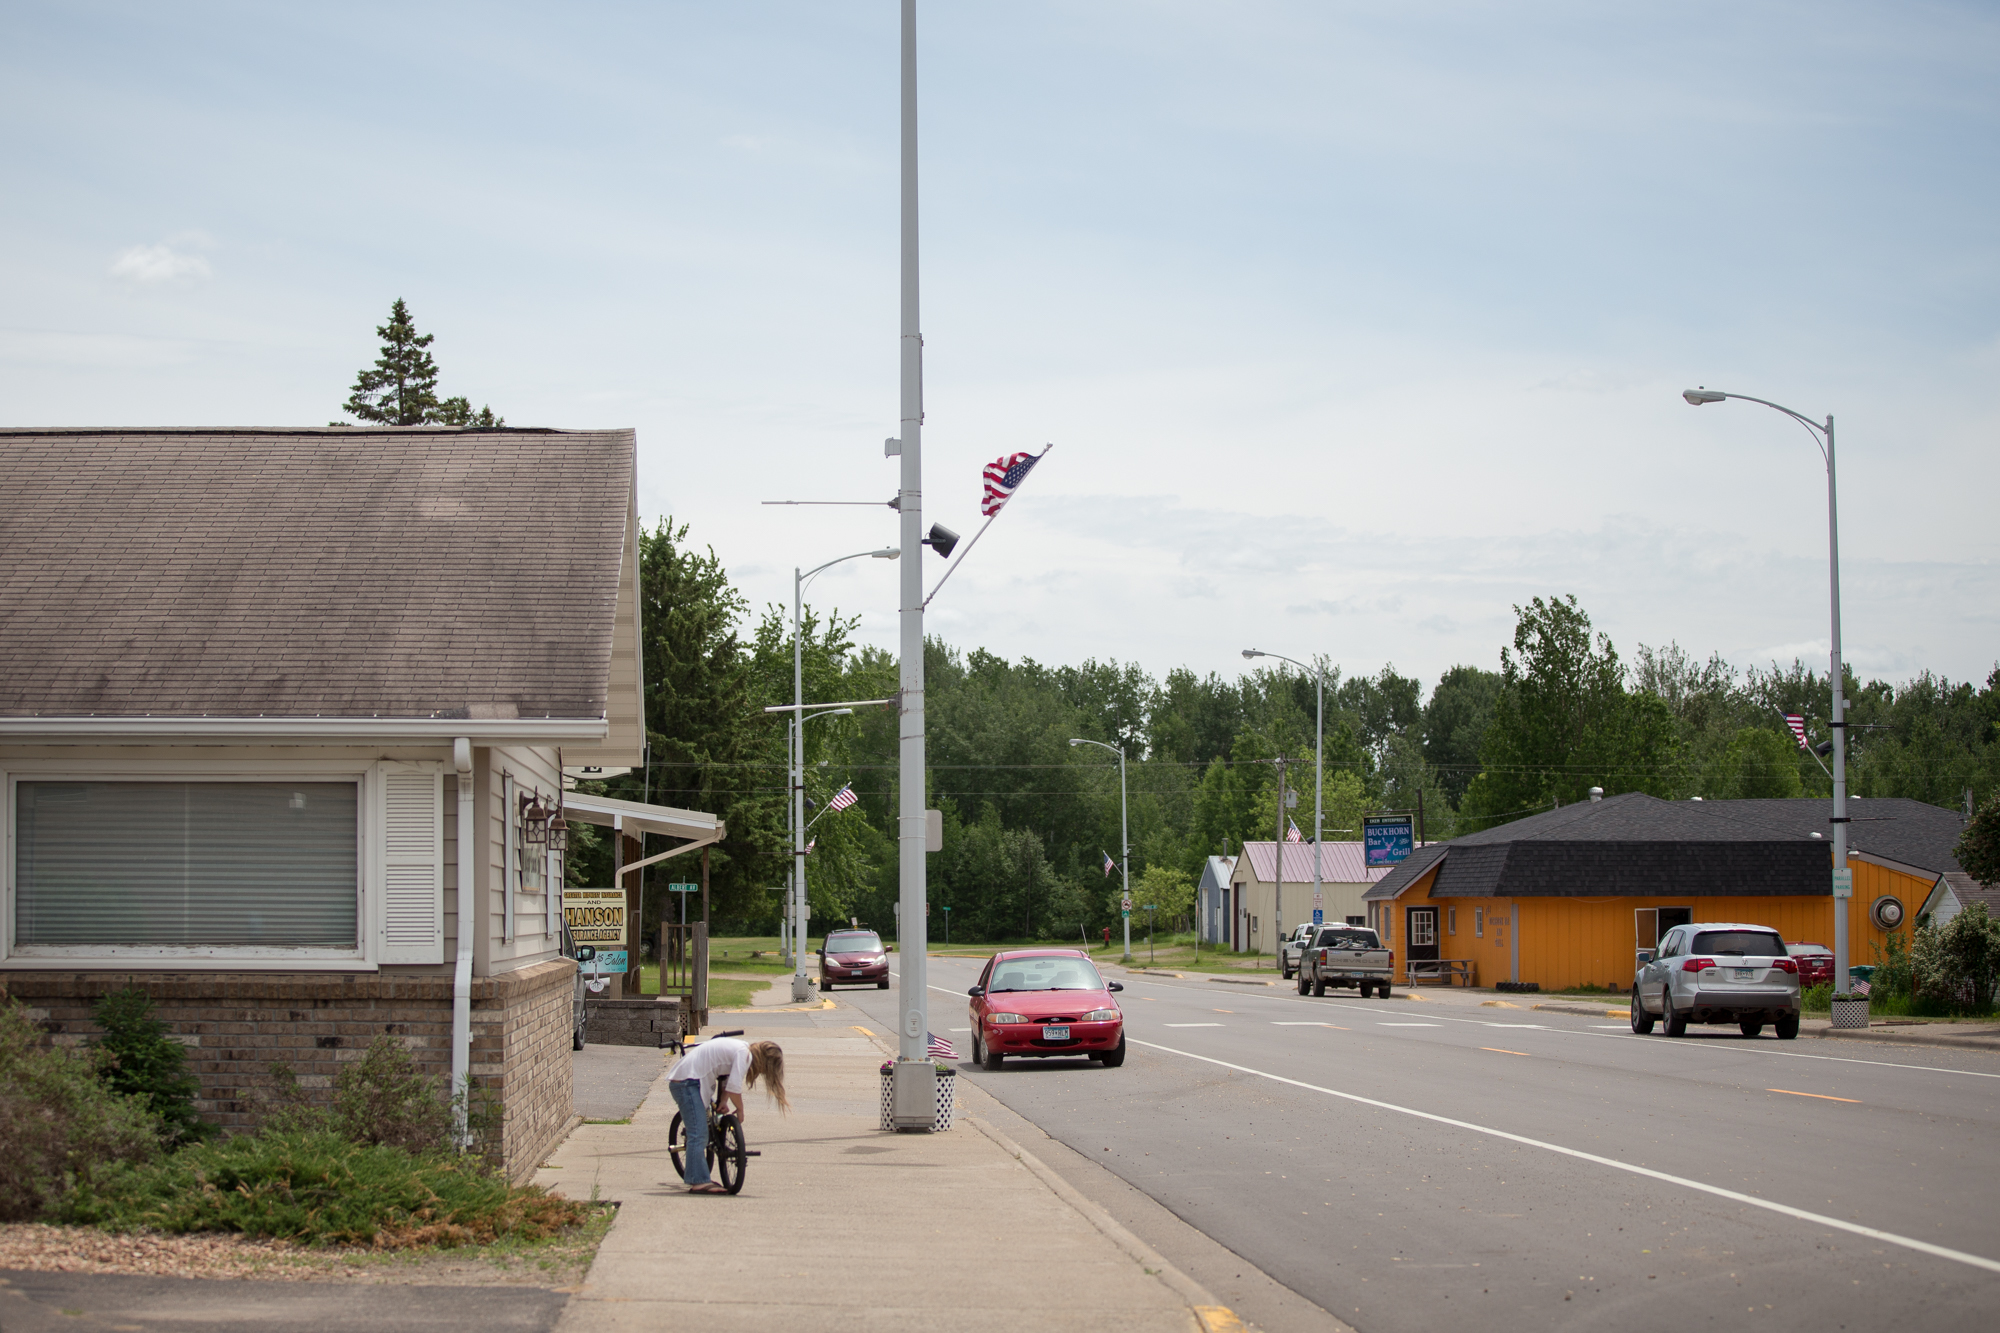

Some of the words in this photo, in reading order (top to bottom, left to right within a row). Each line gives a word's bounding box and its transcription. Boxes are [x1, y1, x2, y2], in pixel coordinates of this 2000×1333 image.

[1367, 827, 1409, 837] BUCKHORN
[1368, 838, 1381, 846] Bar
[1392, 848, 1411, 856] Grill
[564, 907, 623, 927] HANSON
[570, 929, 598, 941] SURANCE
[598, 929, 621, 941] AGENCY
